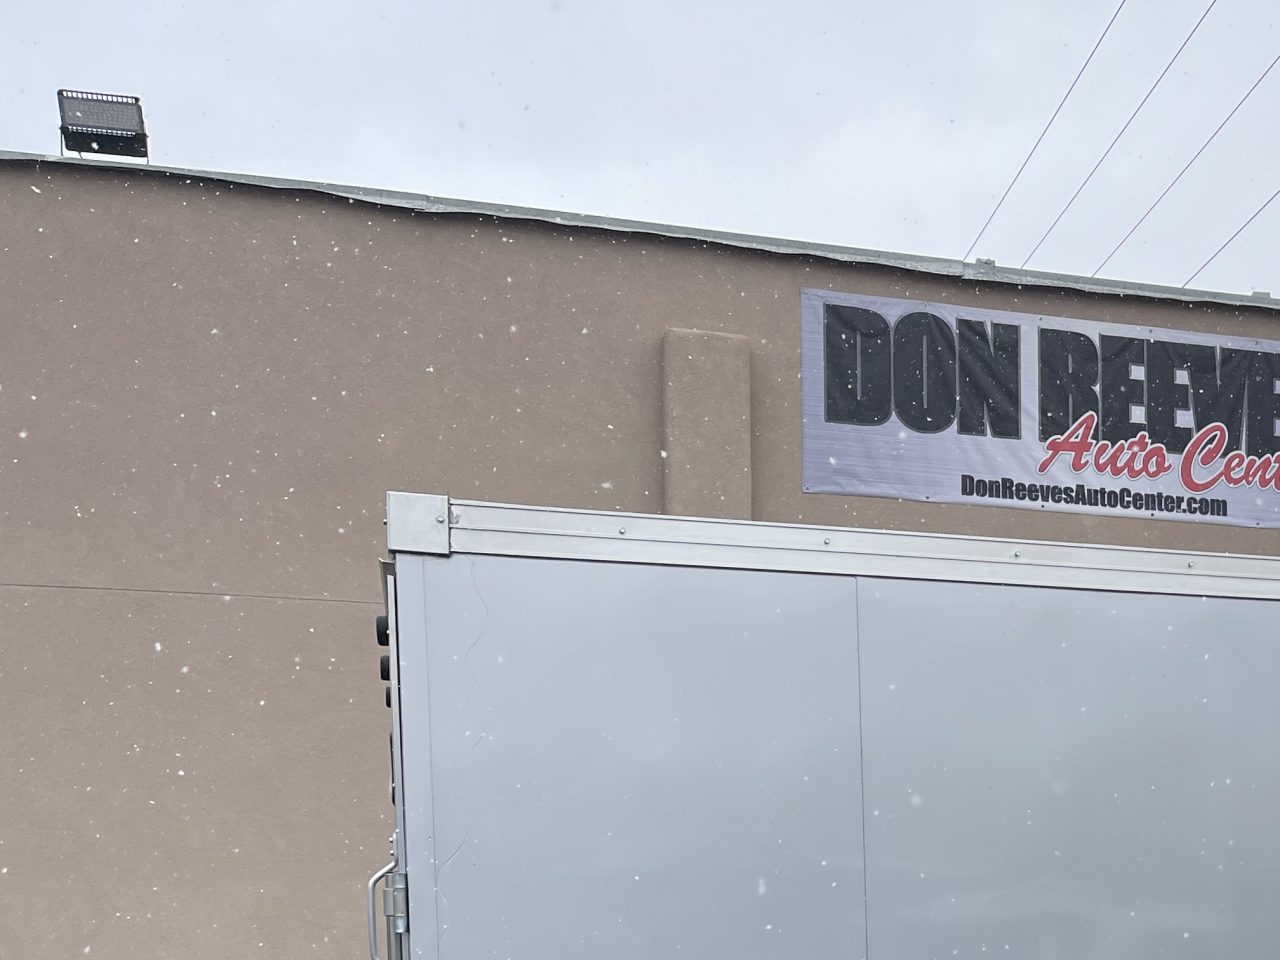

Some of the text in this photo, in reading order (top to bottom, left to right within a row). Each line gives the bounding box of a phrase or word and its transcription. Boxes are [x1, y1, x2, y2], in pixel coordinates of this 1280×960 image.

[823, 302, 1022, 440] DON
[1036, 410, 1173, 480] Auto
[960, 473, 1228, 517] DonReevesAutoCenter.com
